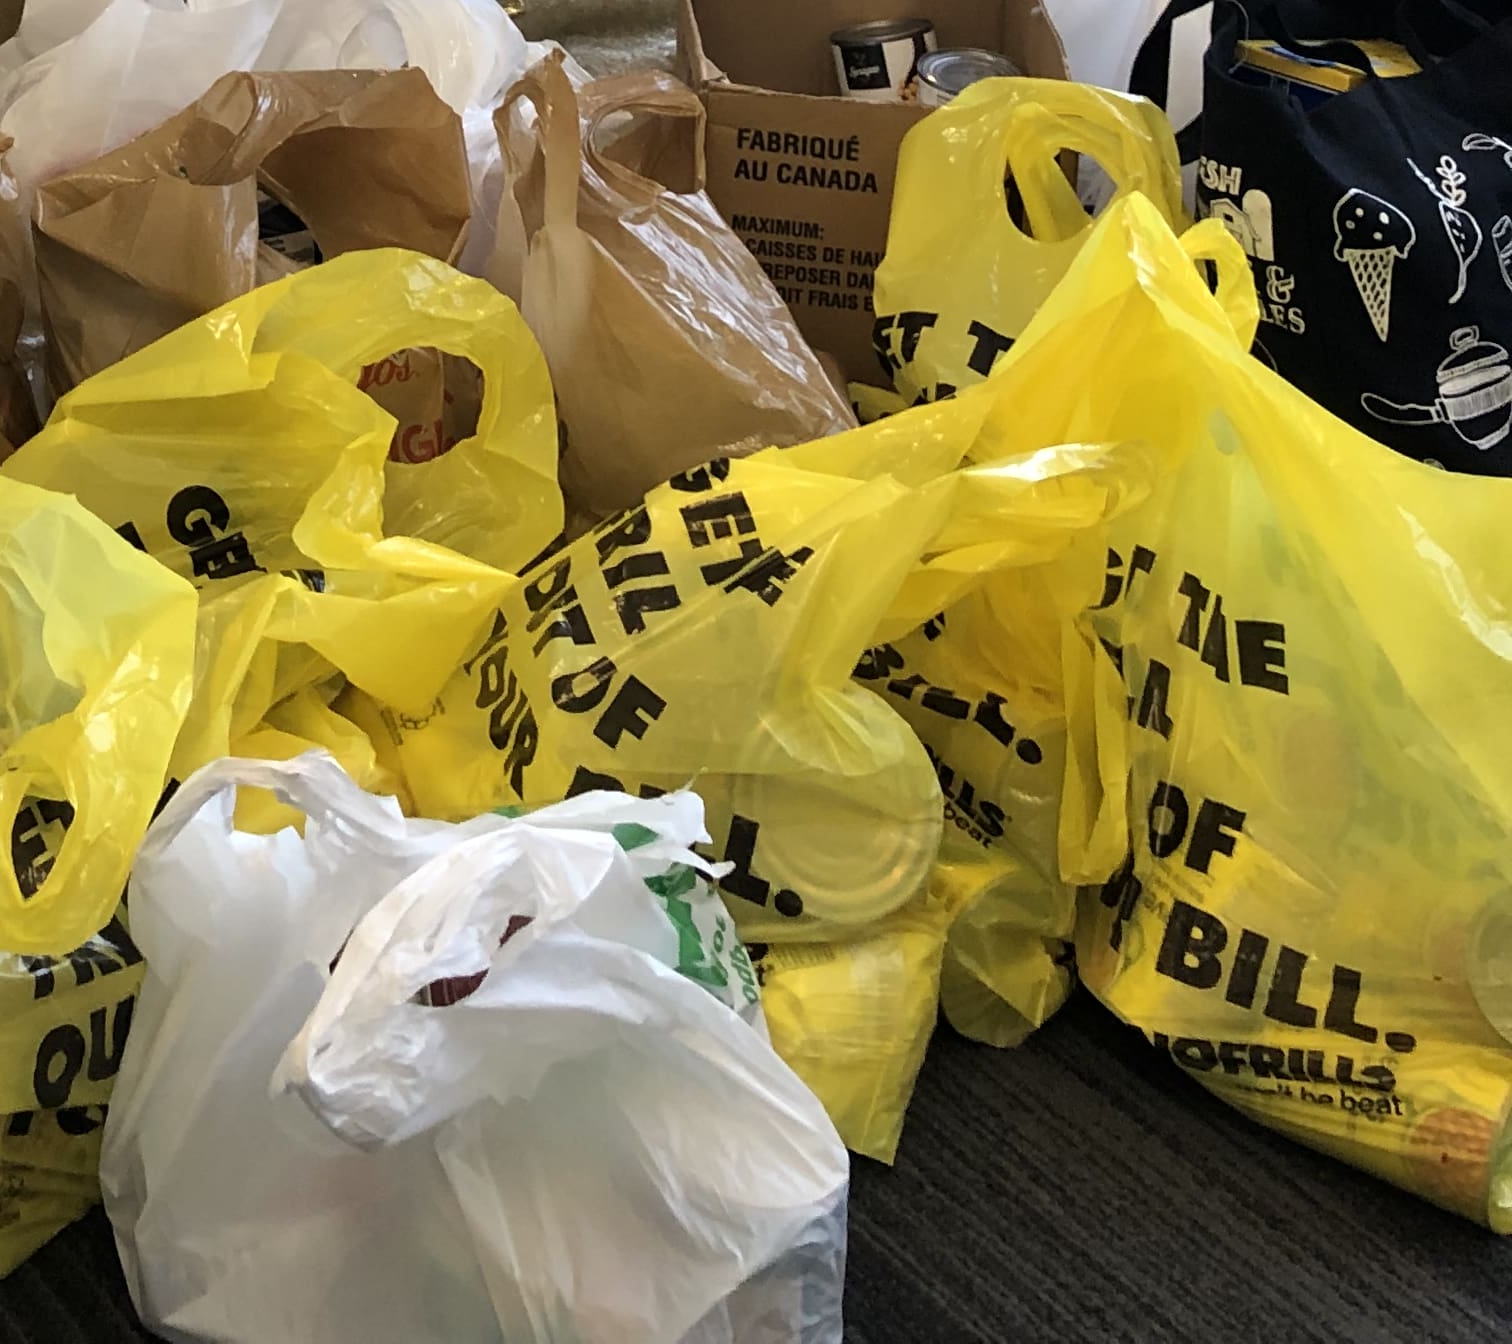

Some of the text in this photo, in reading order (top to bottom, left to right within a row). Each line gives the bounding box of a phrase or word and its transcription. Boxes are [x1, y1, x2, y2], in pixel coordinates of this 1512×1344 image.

[737, 127, 860, 161] FABRIQUÉ
[734, 159, 879, 193] AU CANADA
[731, 214, 825, 241] MAXIMUM:
[822, 247, 846, 264] DE
[807, 290, 859, 311] FRAIS
[1146, 780, 1247, 875] OF
[1155, 897, 1418, 1055] BILL.
